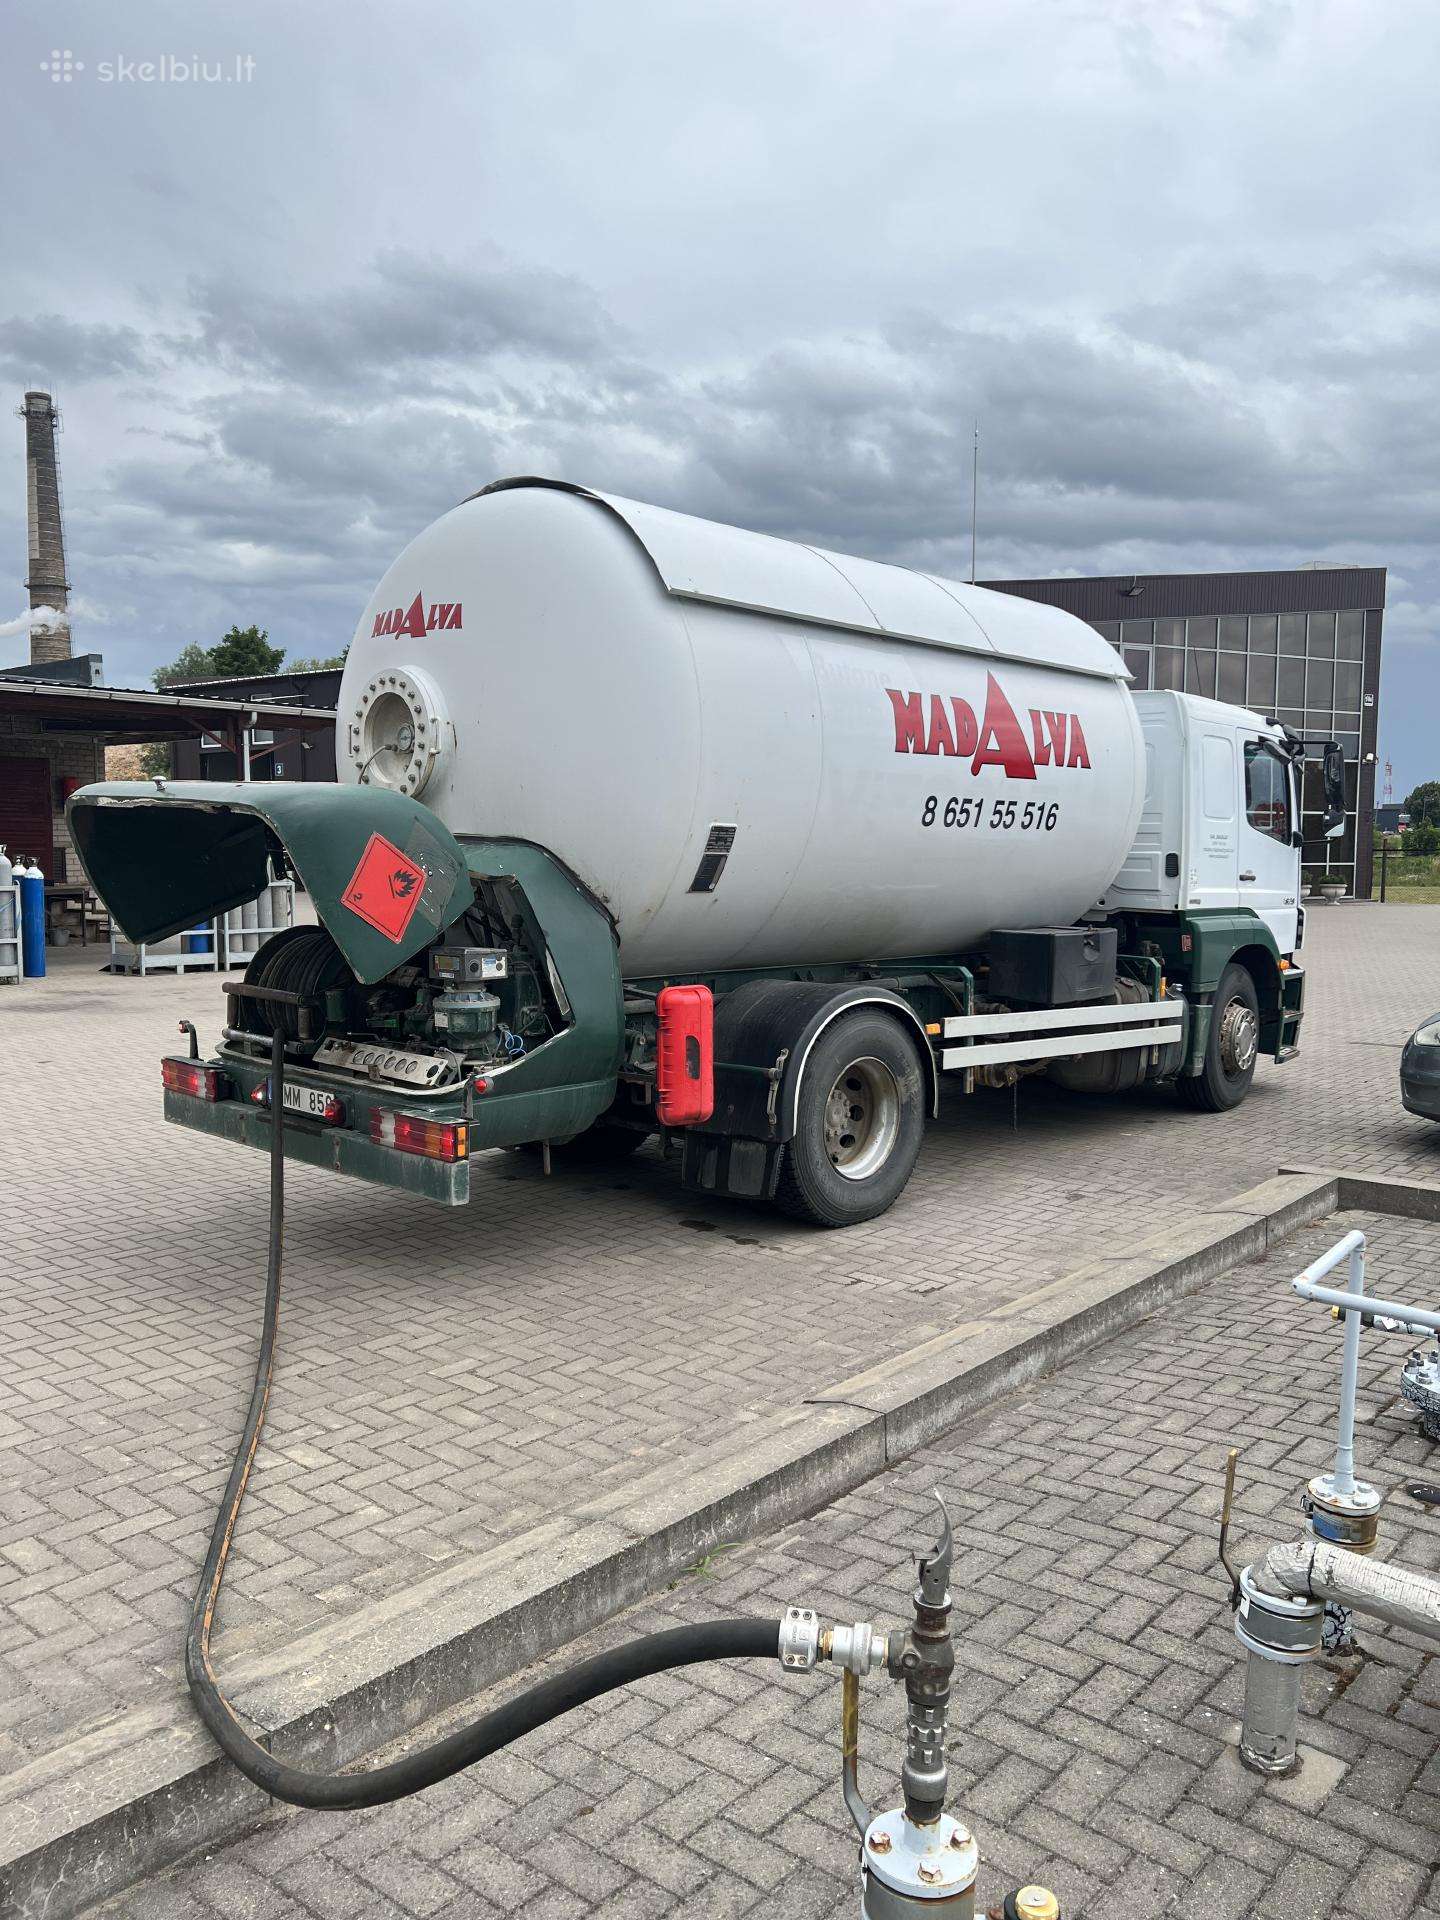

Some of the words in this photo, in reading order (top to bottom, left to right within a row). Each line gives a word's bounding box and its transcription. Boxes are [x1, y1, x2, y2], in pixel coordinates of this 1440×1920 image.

[371, 591, 463, 640] MADALVA
[885, 670, 1092, 780] MADALVA
[921, 795, 938, 827] 8
[943, 796, 984, 828] 651
[989, 799, 1018, 830] 55
[1020, 801, 1060, 832] 516
[283, 1084, 301, 1108] MM
